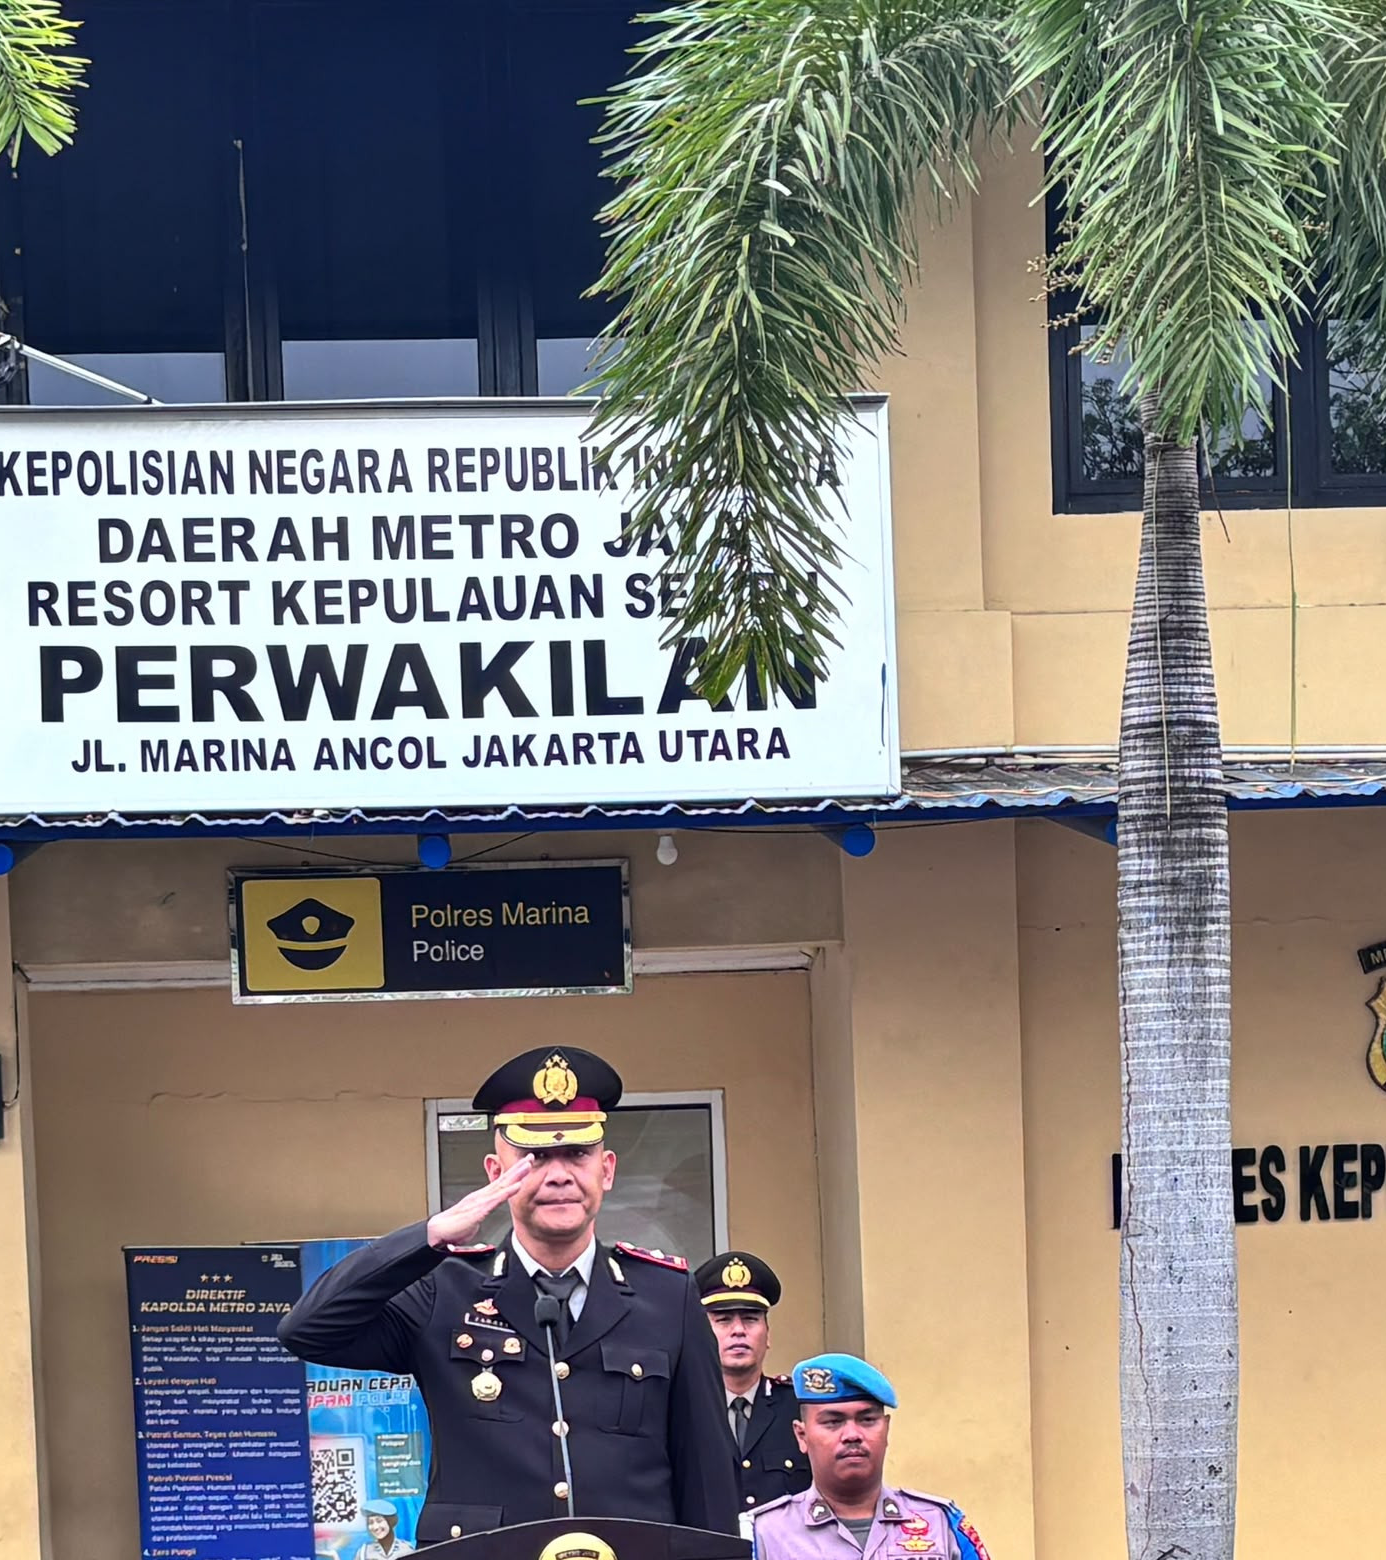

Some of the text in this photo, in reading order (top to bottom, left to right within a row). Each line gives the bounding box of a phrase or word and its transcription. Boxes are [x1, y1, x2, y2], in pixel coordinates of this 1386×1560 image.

[248, 447, 414, 495] NEGARA
[427, 445, 618, 492] REPUBLIK
[97, 515, 351, 564] DAERAH
[372, 513, 580, 560] METRO
[28, 579, 251, 627] RESORT
[273, 573, 604, 625] KEPULAUAN
[40, 634, 817, 723] PERWAKILAN
[71, 728, 792, 774] JL. MARINA ANCOL JAKARTA UTARA
[412, 901, 590, 927] Polres Marina
[413, 940, 484, 962] Police
[140, 1301, 292, 1313] KAPOLDA METRO JAYA
[185, 1289, 246, 1300] DIREKTIF
[368, 1375, 412, 1391] CEPA
[308, 1393, 352, 1407] PAM
